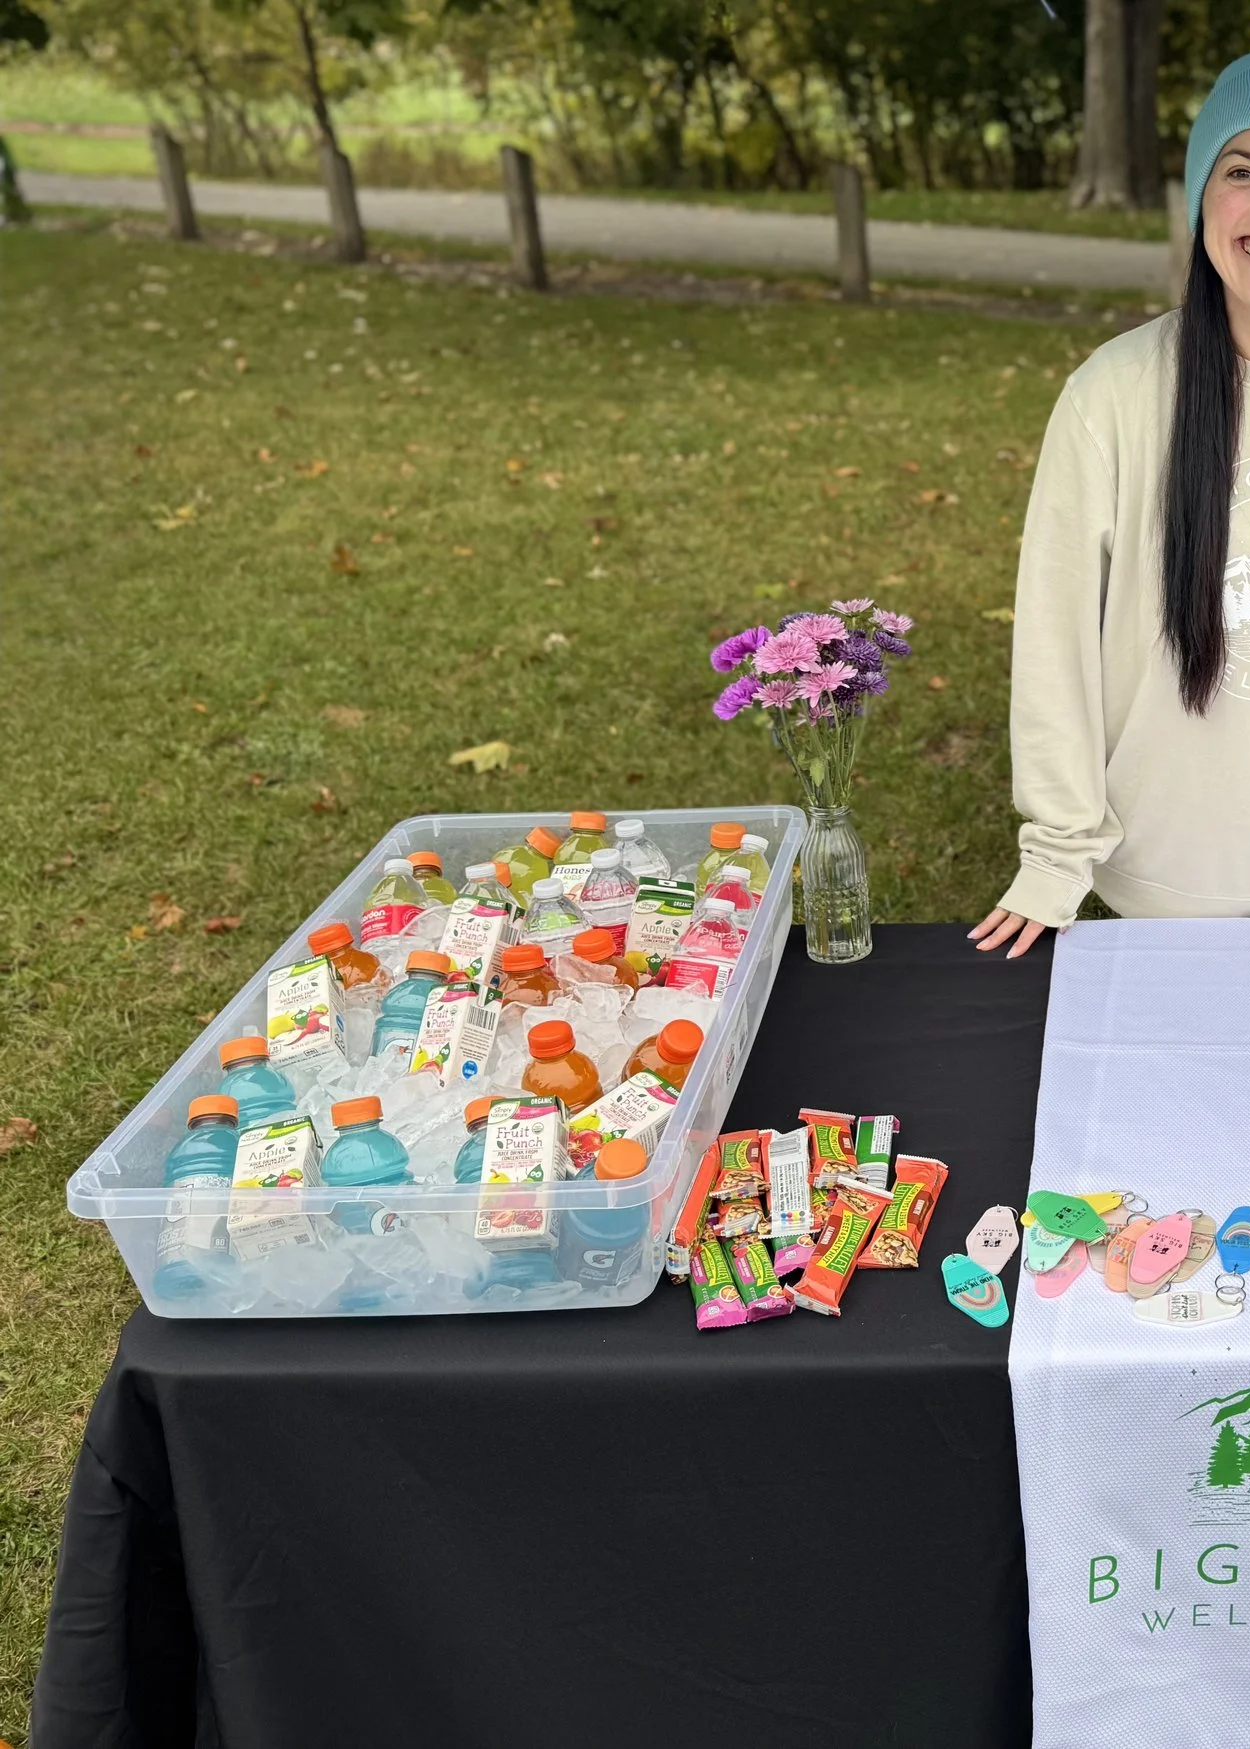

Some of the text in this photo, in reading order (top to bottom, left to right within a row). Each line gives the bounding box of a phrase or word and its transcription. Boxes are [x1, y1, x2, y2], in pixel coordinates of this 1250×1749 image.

[455, 918, 480, 932] Fruit
[642, 923, 671, 934] Apple
[460, 930, 488, 942] Punch
[279, 982, 310, 998] Apple
[427, 1009, 448, 1019] Fruit
[431, 1018, 454, 1028] Punch
[622, 1088, 649, 1107] Fruit
[620, 1099, 646, 1120] Punch
[496, 1126, 529, 1139] Fruit
[506, 1137, 543, 1149] Punch
[249, 1147, 285, 1160] Apple
[839, 1214, 853, 1232] SWEET
[896, 1211, 908, 1227] SWEET
[829, 1215, 867, 1272] NATURE VALLEY
[832, 1235, 845, 1252] SALTY
[1148, 1233, 1182, 1248] BIG SKY
[821, 1249, 835, 1265] NUT
[949, 1284, 969, 1296] STIGMA
[968, 1280, 979, 1288] THE
[1089, 1542, 1240, 1604] BIG
